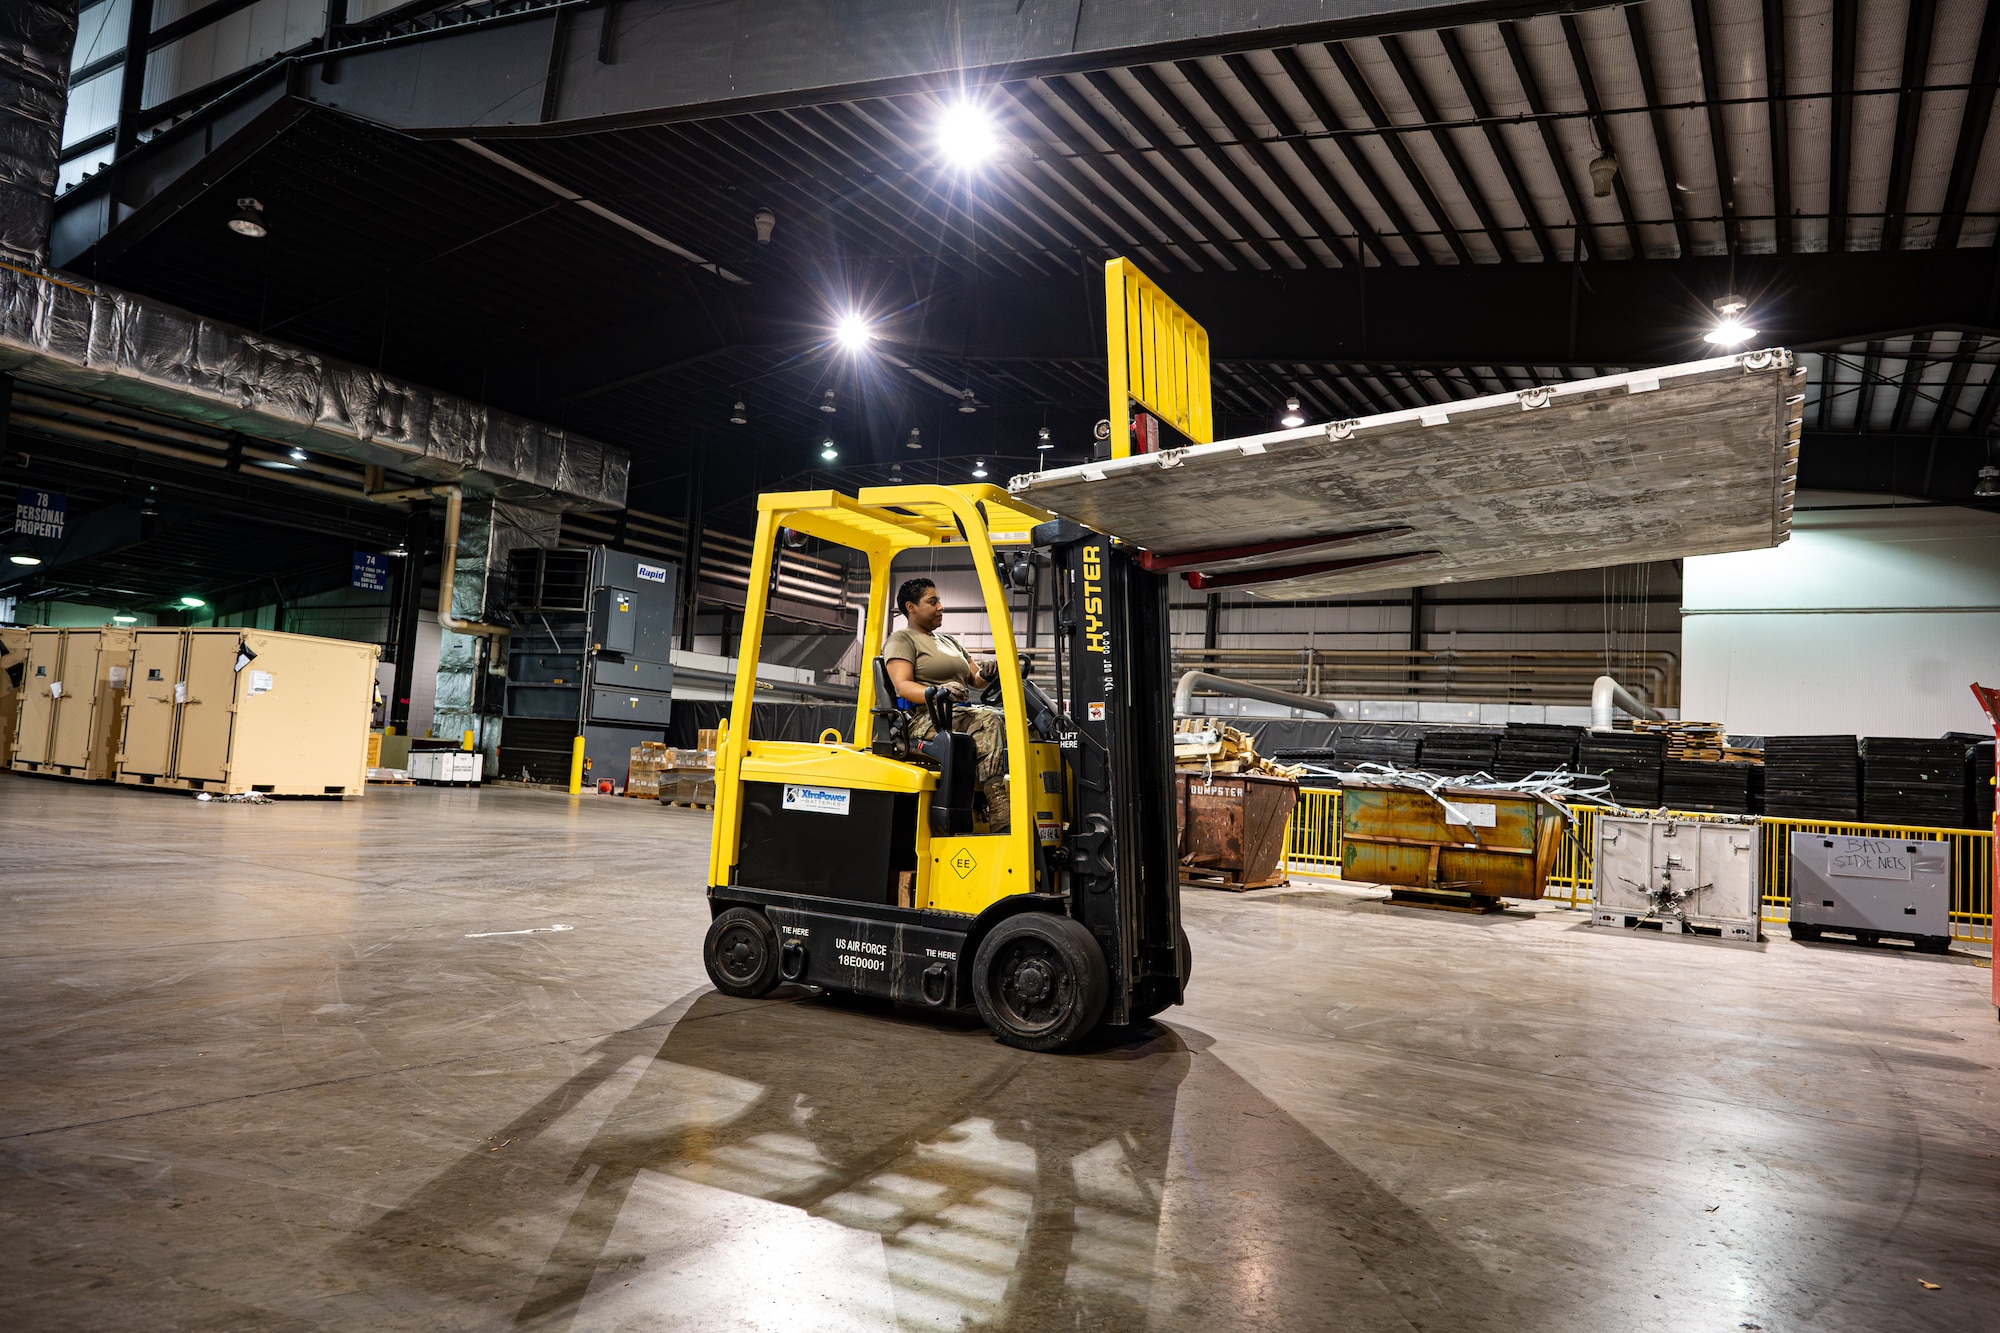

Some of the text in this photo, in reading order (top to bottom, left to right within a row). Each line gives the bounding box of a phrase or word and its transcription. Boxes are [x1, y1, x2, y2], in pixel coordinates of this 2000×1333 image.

[37, 493, 49, 507] 78
[16, 504, 65, 525] PERSONAL
[15, 519, 63, 539] PROPERTY
[366, 555, 376, 565] 74
[639, 567, 665, 579] Rapid
[1082, 545, 1104, 652] HYSTER
[1060, 731, 1078, 740] LIFT
[1060, 740, 1078, 749] HERE
[802, 790, 846, 802] XtraPower
[1191, 786, 1243, 797] DUMPSTER
[806, 799, 840, 807] BATTERIES
[1845, 839, 1891, 854] BAD
[957, 858, 970, 868] EE
[782, 926, 809, 937] TIE HERE
[835, 938, 887, 956] US AIR FORCE
[926, 949, 957, 961] TIE HERE
[838, 954, 885, 972] 18E00001
